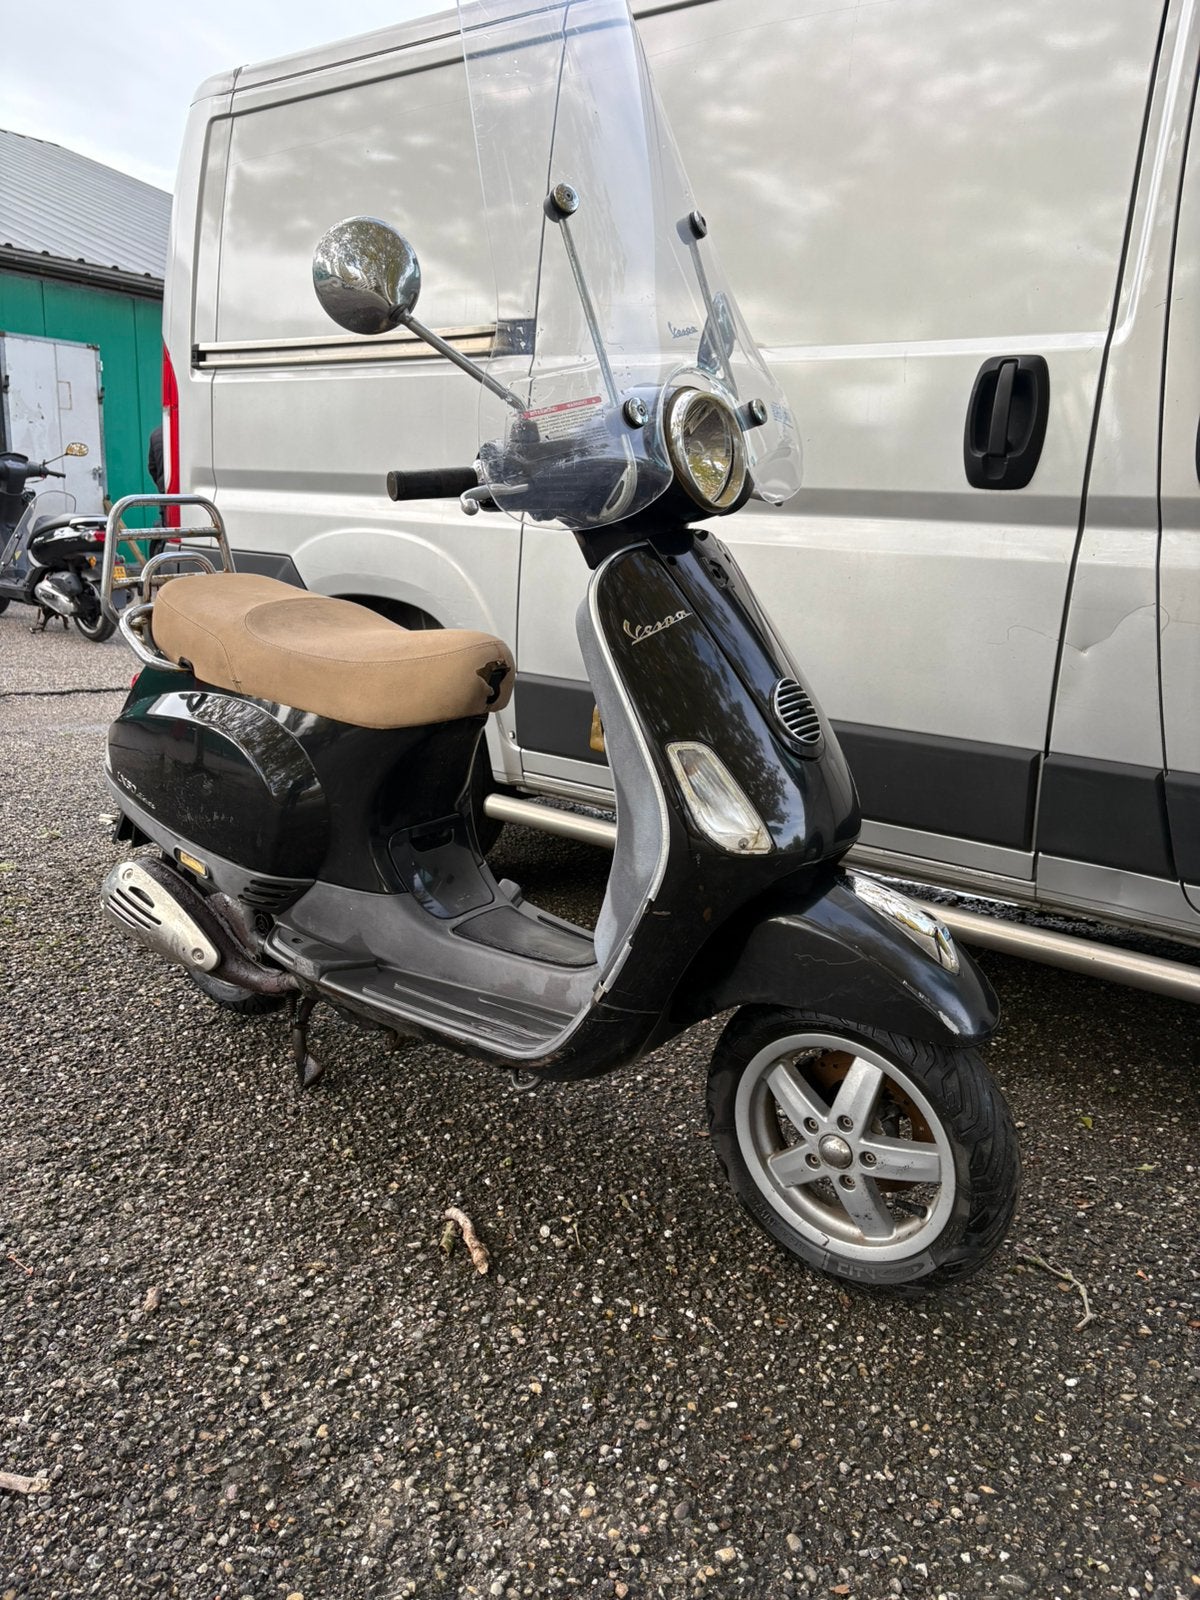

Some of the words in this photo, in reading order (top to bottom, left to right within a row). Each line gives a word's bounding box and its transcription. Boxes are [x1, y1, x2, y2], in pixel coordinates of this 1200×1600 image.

[667, 320, 699, 339] Vespa
[622, 609, 693, 646] Vespa
[837, 1261, 876, 1280] CITY
